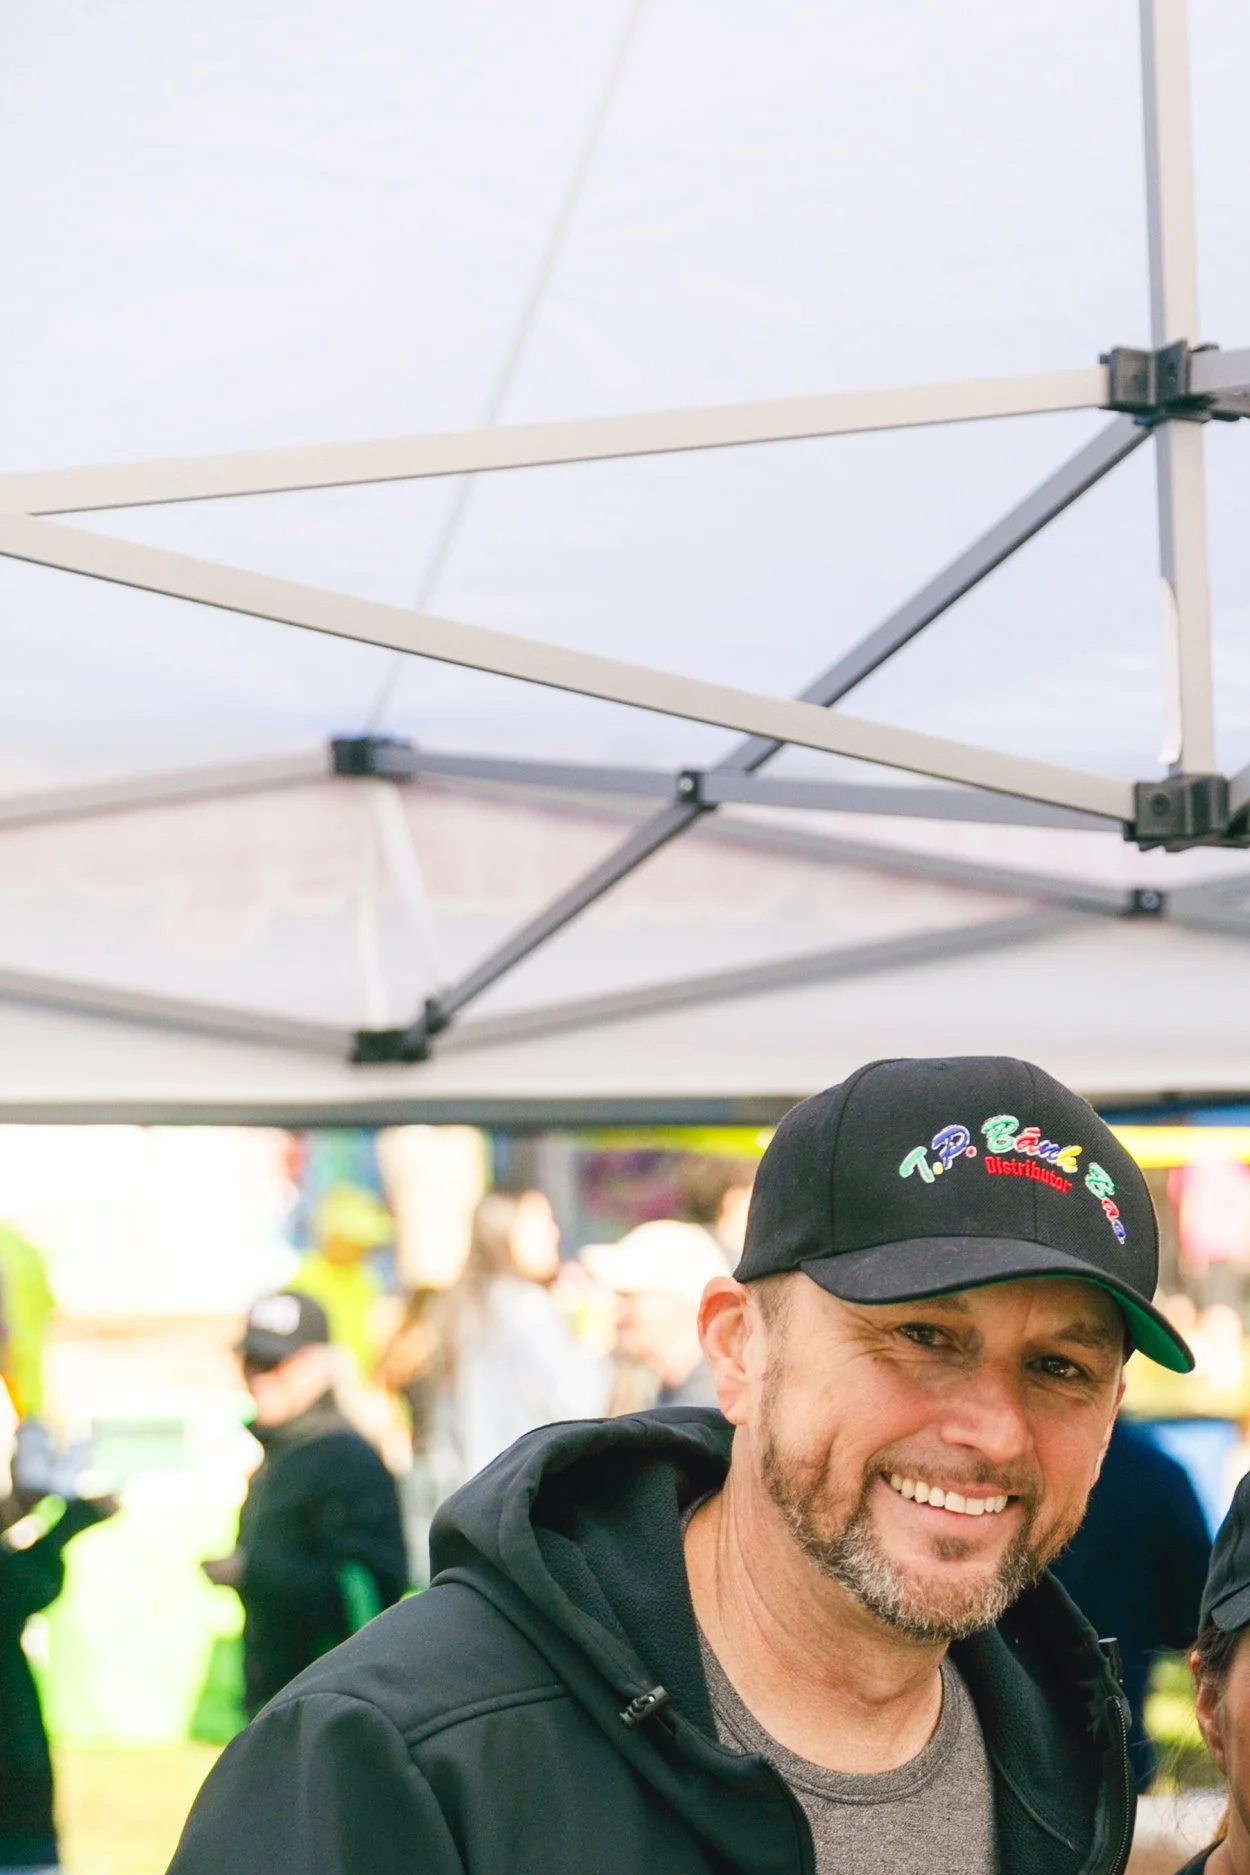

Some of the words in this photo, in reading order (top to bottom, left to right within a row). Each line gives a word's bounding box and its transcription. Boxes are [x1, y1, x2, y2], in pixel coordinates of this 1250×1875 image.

[899, 1124, 977, 1184] T.P.
[1085, 1162, 1128, 1245] Bao
[984, 1156, 1073, 1195] Distributor
